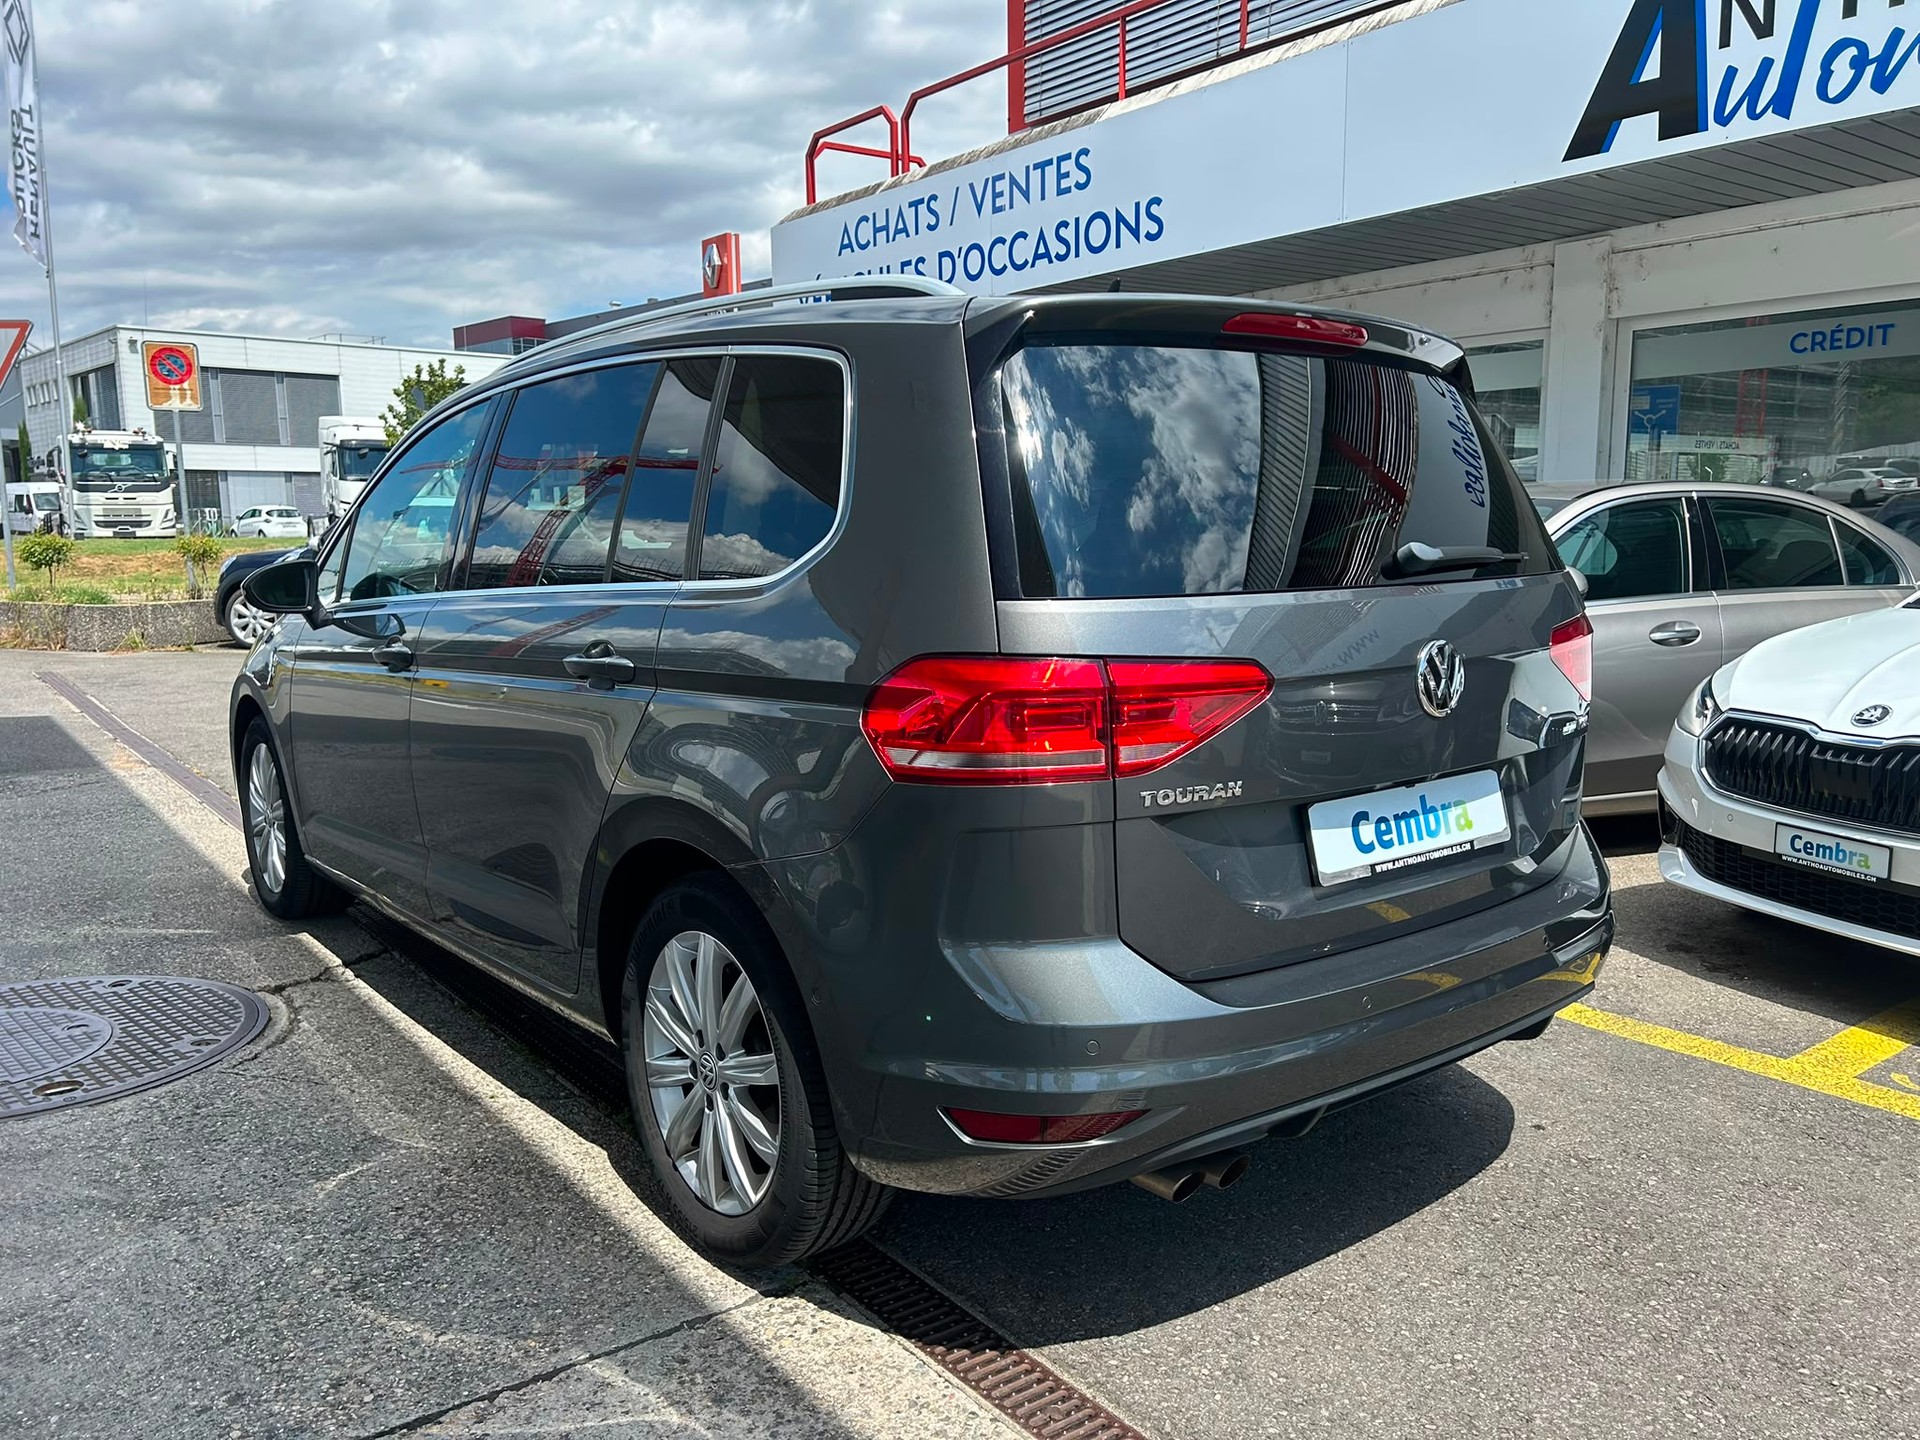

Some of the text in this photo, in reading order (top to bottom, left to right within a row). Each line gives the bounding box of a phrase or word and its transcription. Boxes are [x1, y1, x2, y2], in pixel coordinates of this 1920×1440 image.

[837, 147, 1092, 257] ACHATS / VENTES
[937, 195, 1165, 284] D'OCCASIONS
[1788, 323, 1897, 354] CRÉDIT
[1139, 780, 1243, 808] TOURAN
[1351, 793, 1474, 855] Cembra
[1374, 841, 1472, 874] WWW.ANTHOAUTOMOBILES.CH
[1781, 854, 1877, 882] WWW.ANTHOAUTOMOBILES.CH
[1789, 833, 1871, 870] Cembra
